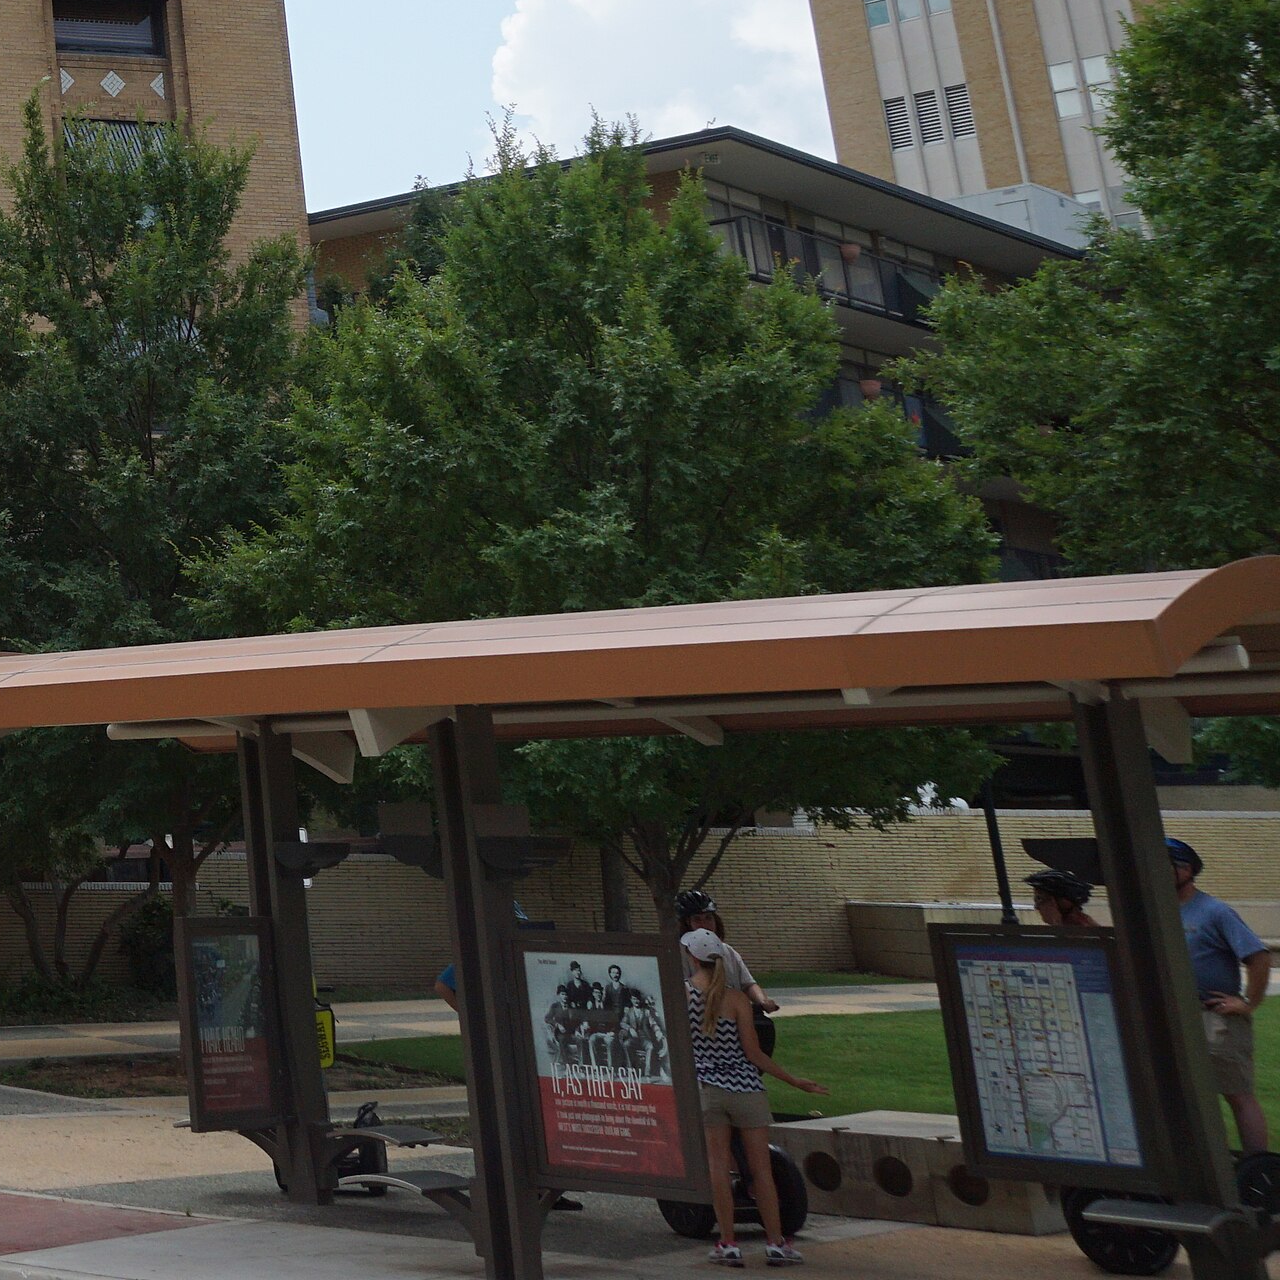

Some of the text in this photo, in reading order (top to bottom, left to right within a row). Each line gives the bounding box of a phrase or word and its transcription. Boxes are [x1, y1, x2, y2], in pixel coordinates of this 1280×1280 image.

[551, 1063, 643, 1100] IF, AS THEY SAY
